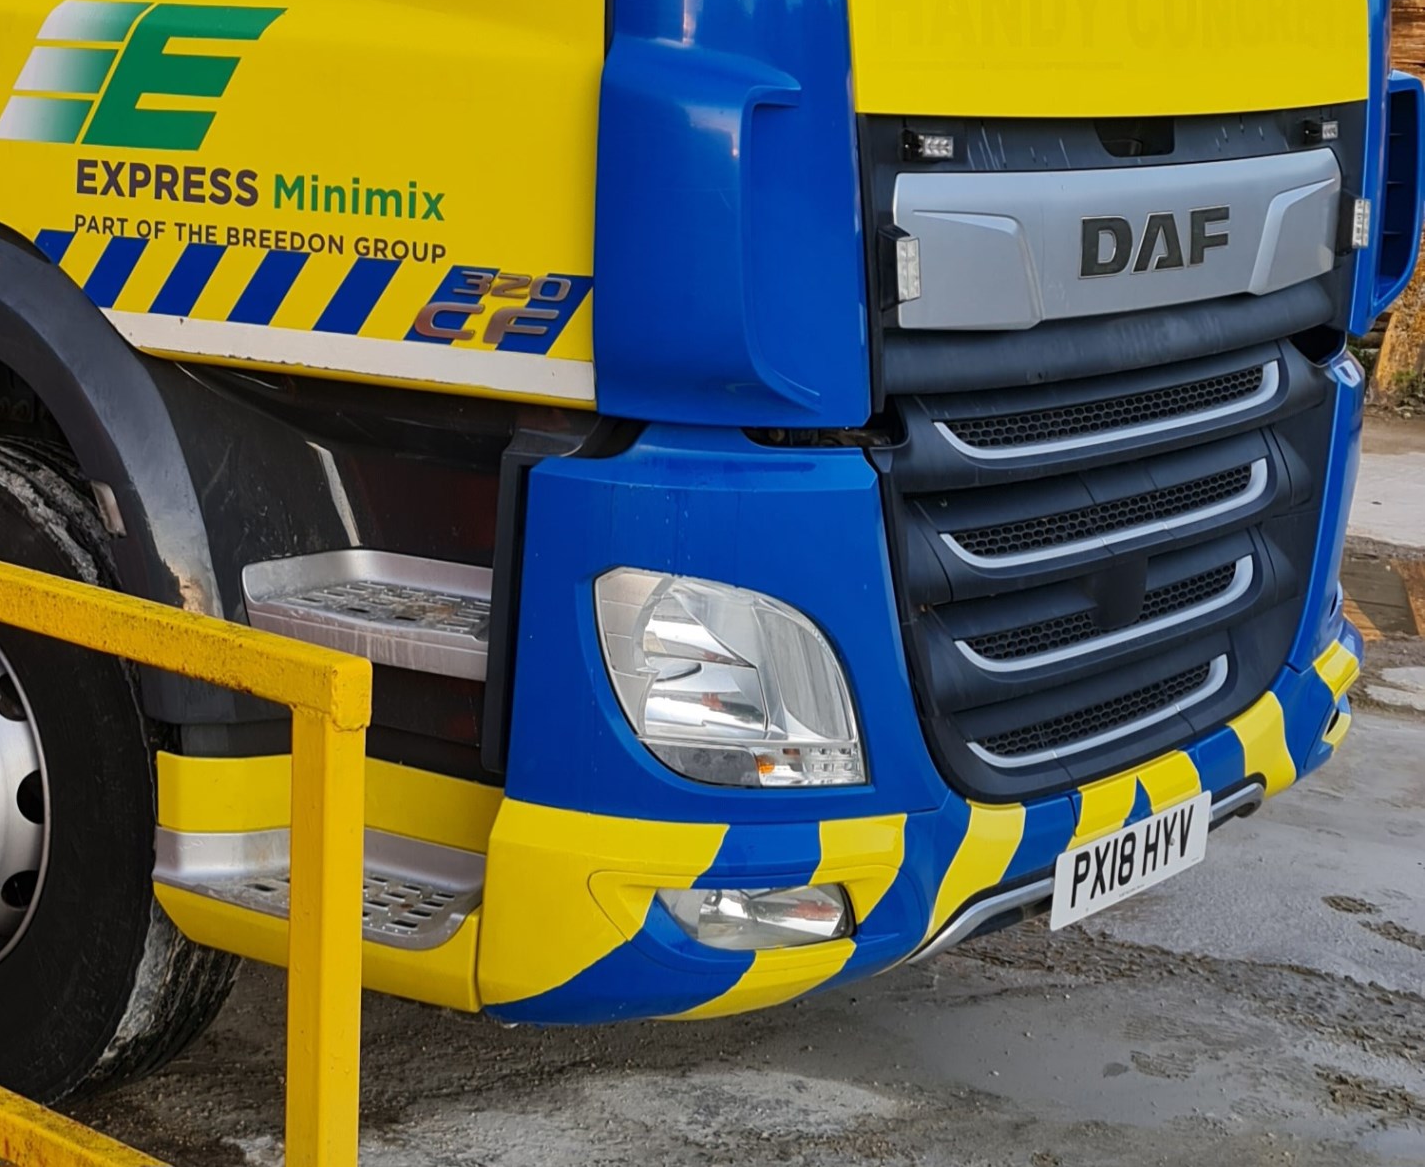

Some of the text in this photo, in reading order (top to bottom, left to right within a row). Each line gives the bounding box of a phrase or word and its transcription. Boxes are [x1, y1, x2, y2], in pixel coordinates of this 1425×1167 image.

[76, 159, 445, 221] EXPRESS Minimix
[75, 214, 446, 264] PART OF THE BREEDON GROUP
[1078, 204, 1230, 279] DAF
[453, 270, 572, 302] 320
[414, 301, 560, 344] CF
[1071, 804, 1194, 909] PX18 HYV
